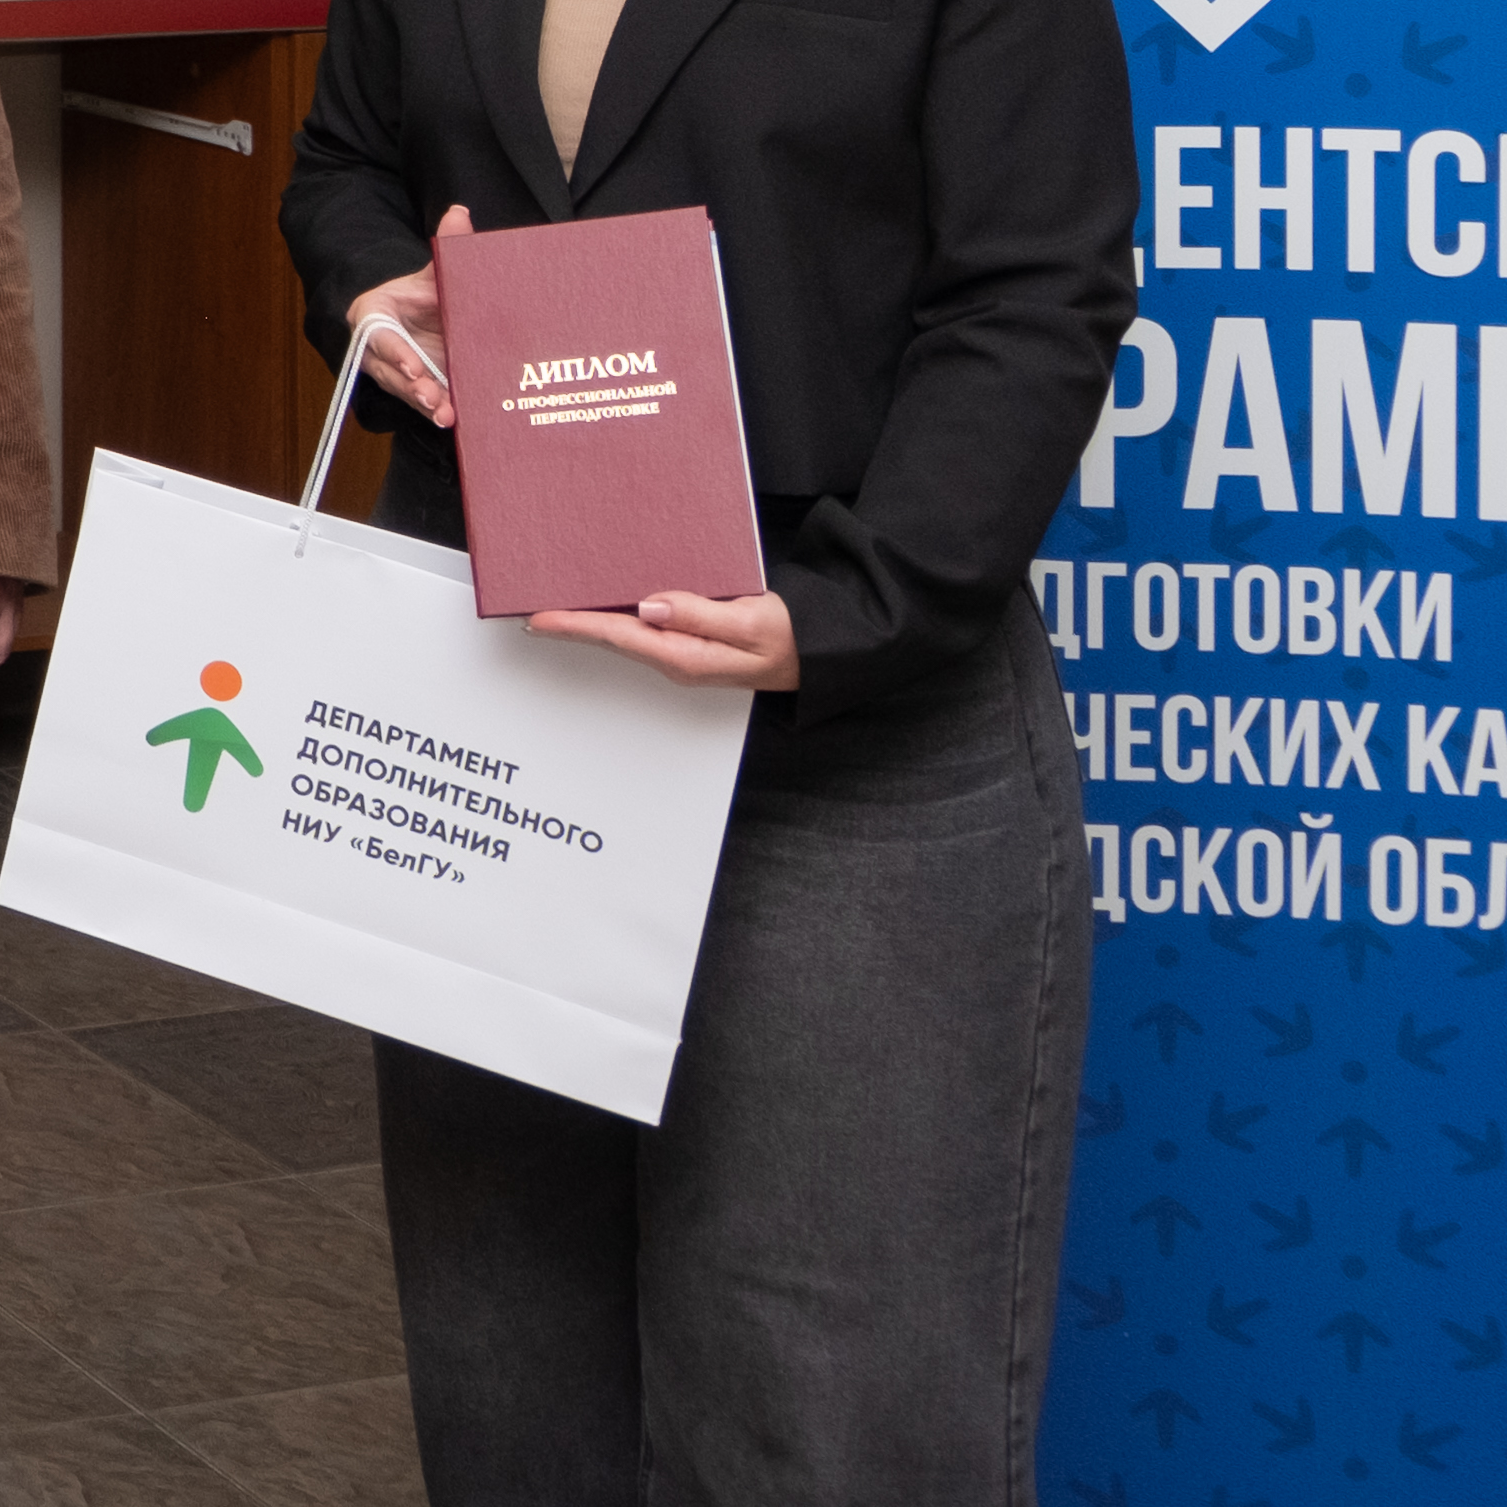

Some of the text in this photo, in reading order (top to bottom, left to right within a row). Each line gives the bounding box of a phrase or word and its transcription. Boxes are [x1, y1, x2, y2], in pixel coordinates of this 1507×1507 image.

[1132, 125, 1507, 288] ЕНТС
[502, 381, 678, 411] О ПРОФЕССИОНАЛЬНОЙ
[519, 350, 657, 391] ДИПЛОМ
[530, 401, 661, 426] ПЕРЕПОДГОТОВКЕ
[1080, 317, 1507, 522] РАМ
[1029, 558, 1453, 662] ДГОТОВКИ
[305, 699, 519, 785] ДЕПАРТАМЕНТ
[1062, 691, 1507, 799] ЧЕСКИХ КА
[291, 774, 510, 862] ОБРАЗОВАНИЯ
[296, 736, 604, 854] ДОПОЛНИТЕЛЬНОГО
[281, 809, 466, 885] НИУ «БелГУ»
[1083, 811, 1507, 931] ДСКОЙ ОБЛ
